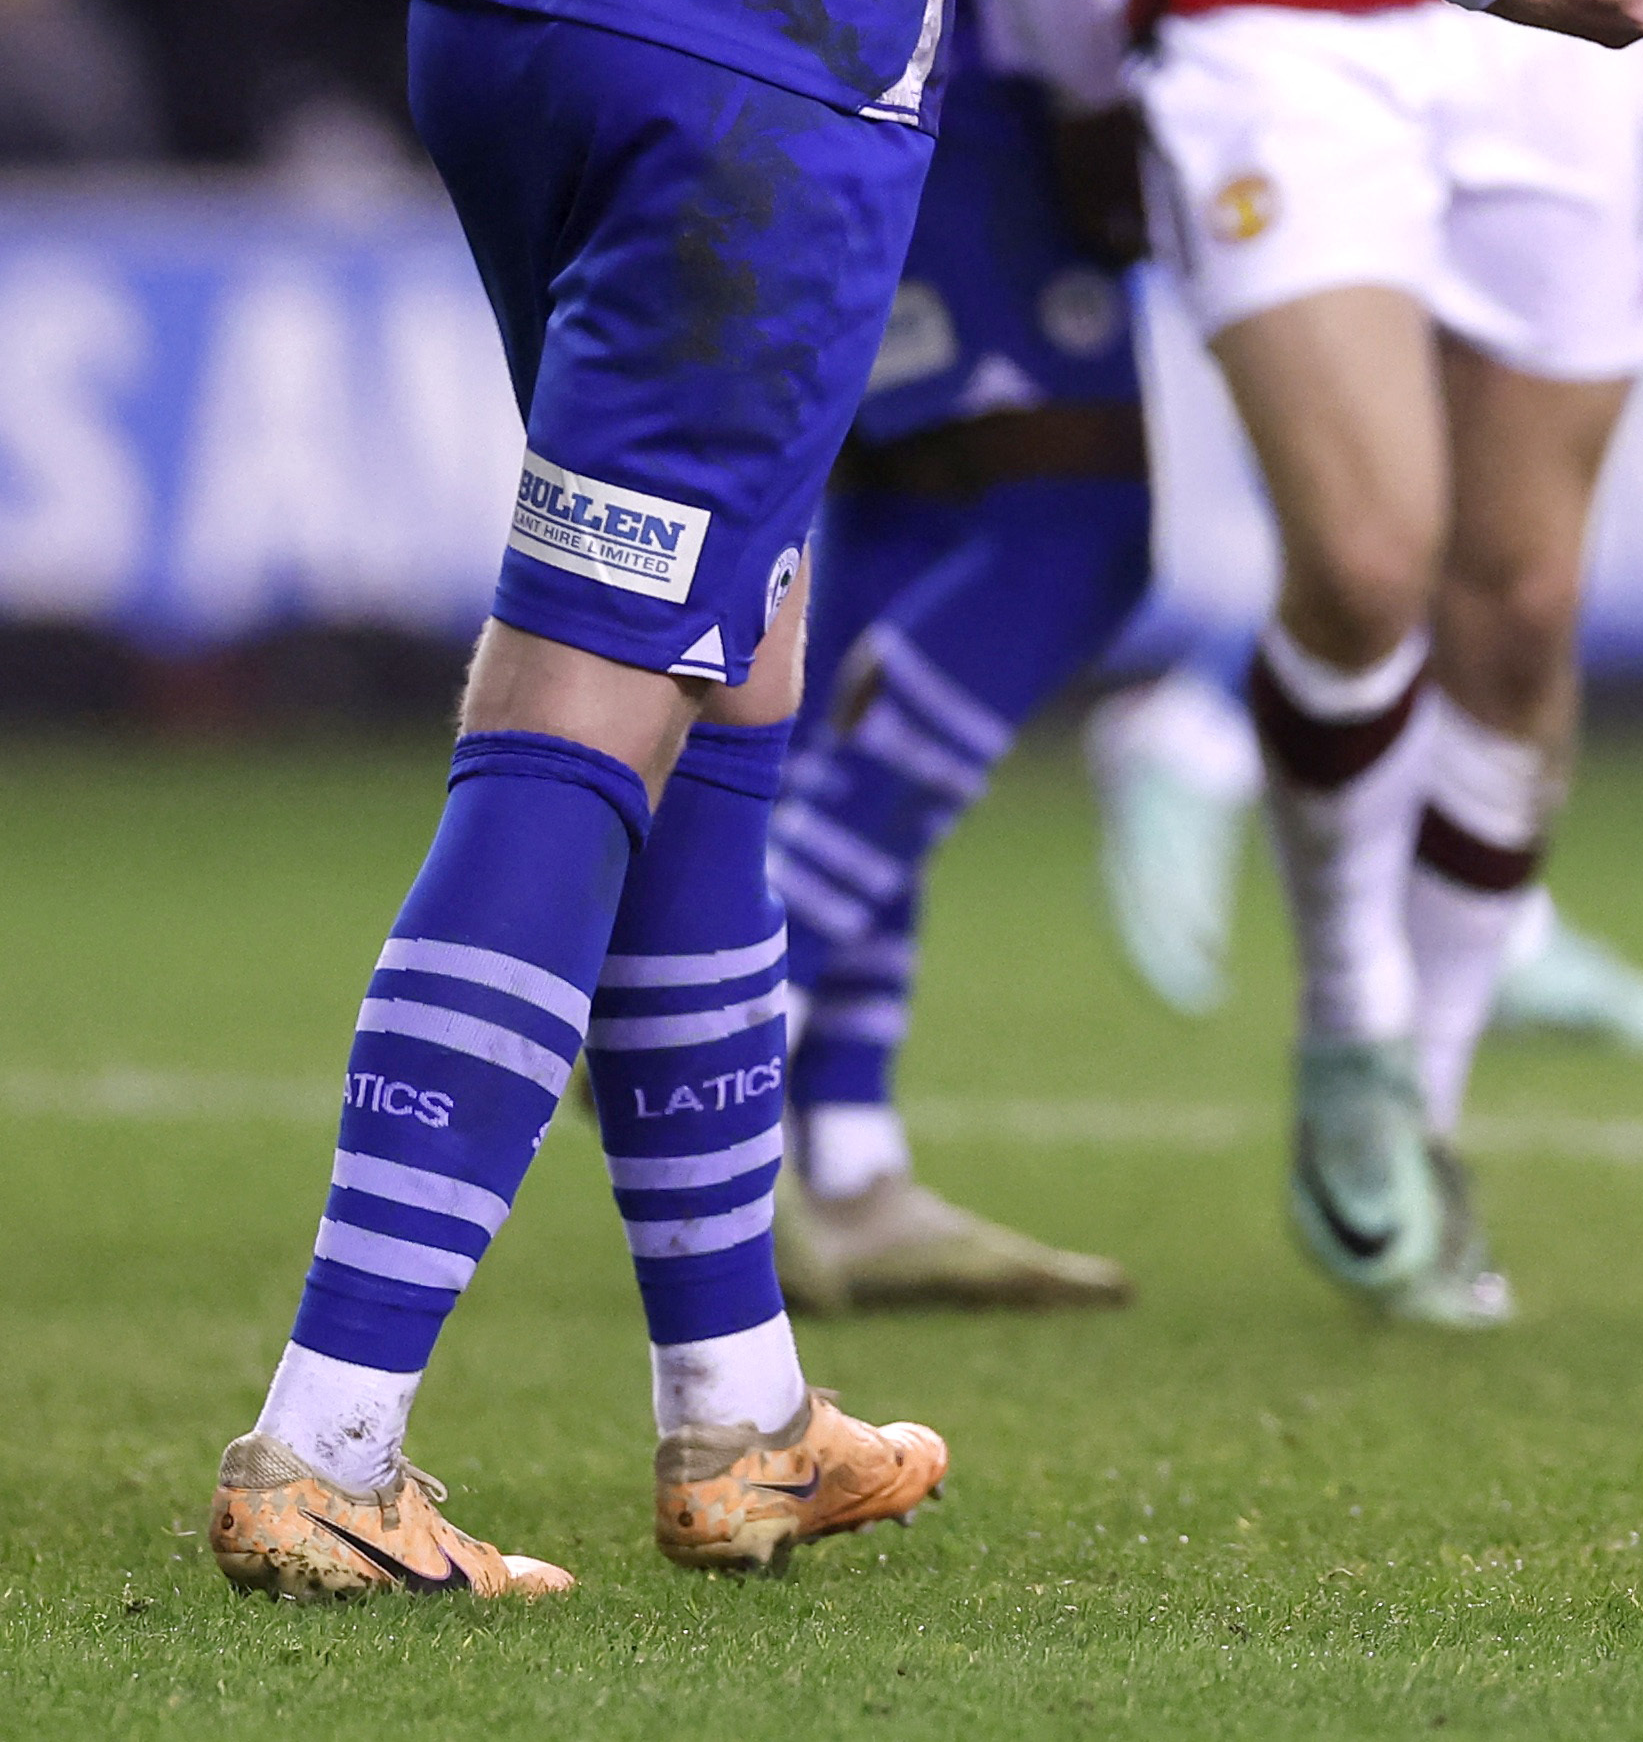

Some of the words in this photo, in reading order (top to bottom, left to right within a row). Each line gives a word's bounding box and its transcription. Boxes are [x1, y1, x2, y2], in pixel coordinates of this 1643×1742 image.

[518, 469, 686, 552] BULLEN
[543, 525, 582, 550] HIRE
[587, 541, 670, 575] LIMITED
[635, 1057, 782, 1118] LATICS
